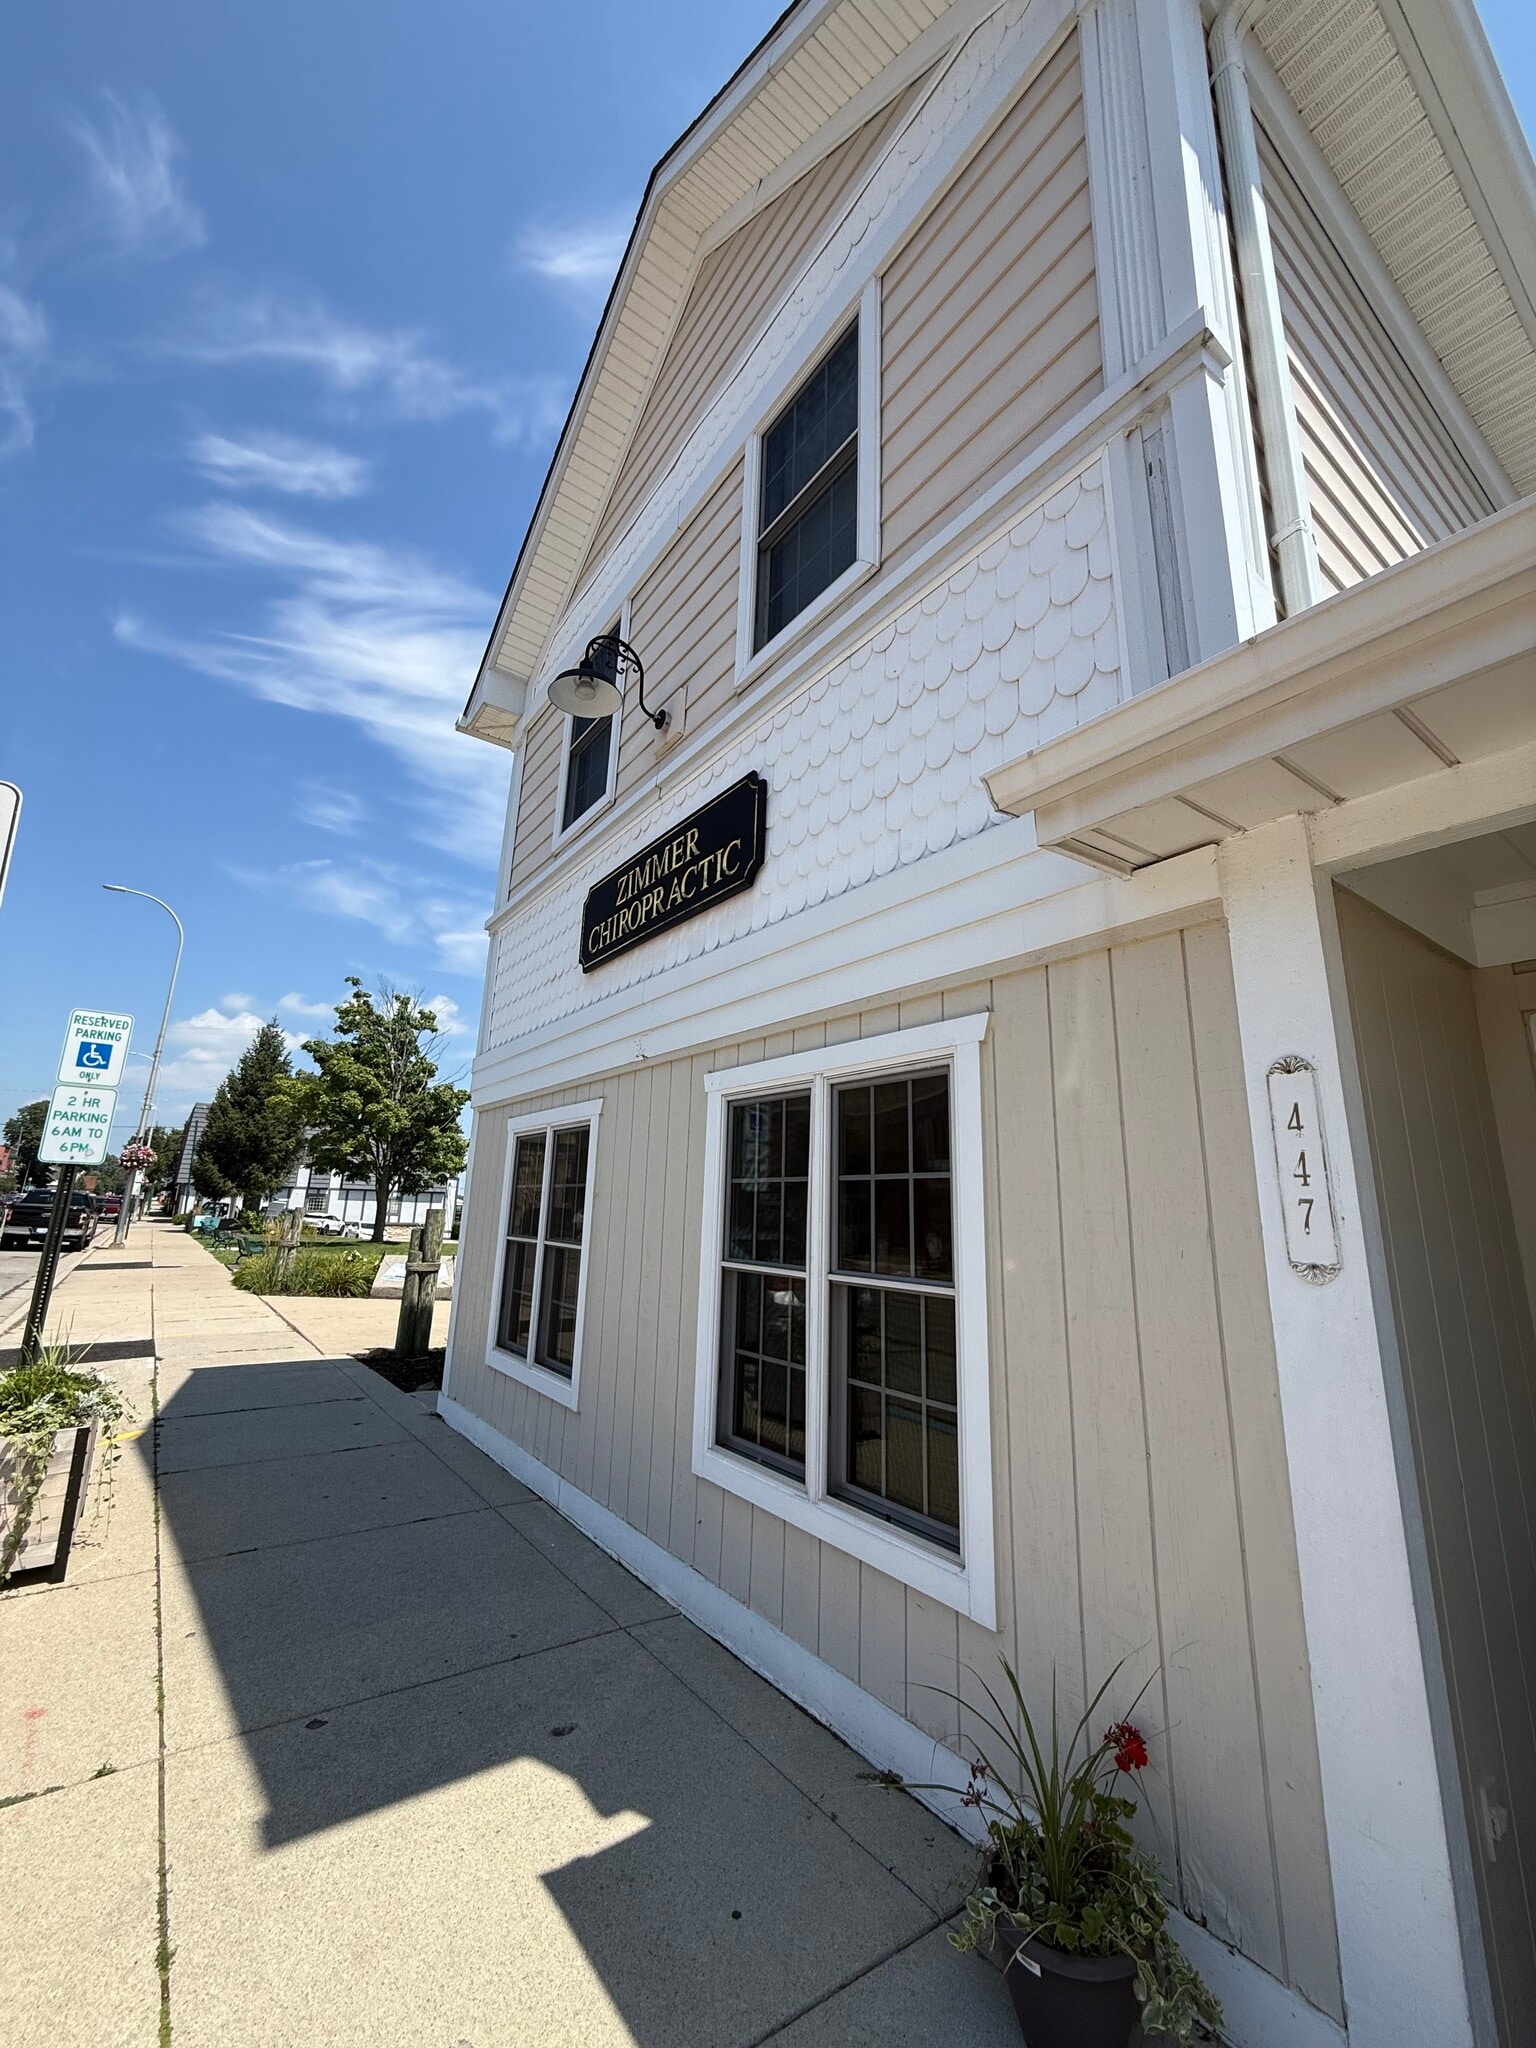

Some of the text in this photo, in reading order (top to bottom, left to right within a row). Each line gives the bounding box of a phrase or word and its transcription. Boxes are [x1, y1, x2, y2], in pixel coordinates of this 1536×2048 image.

[616, 828, 700, 906] ZIMMER
[588, 838, 741, 954] CHIROPRACTIC
[74, 1014, 129, 1030] RESERVED
[75, 1027, 122, 1042] PARKING
[79, 1071, 101, 1080] ONLY
[67, 1096, 100, 1108] 2 HR
[52, 1110, 108, 1124] PARKING
[88, 1128, 103, 1139] TO
